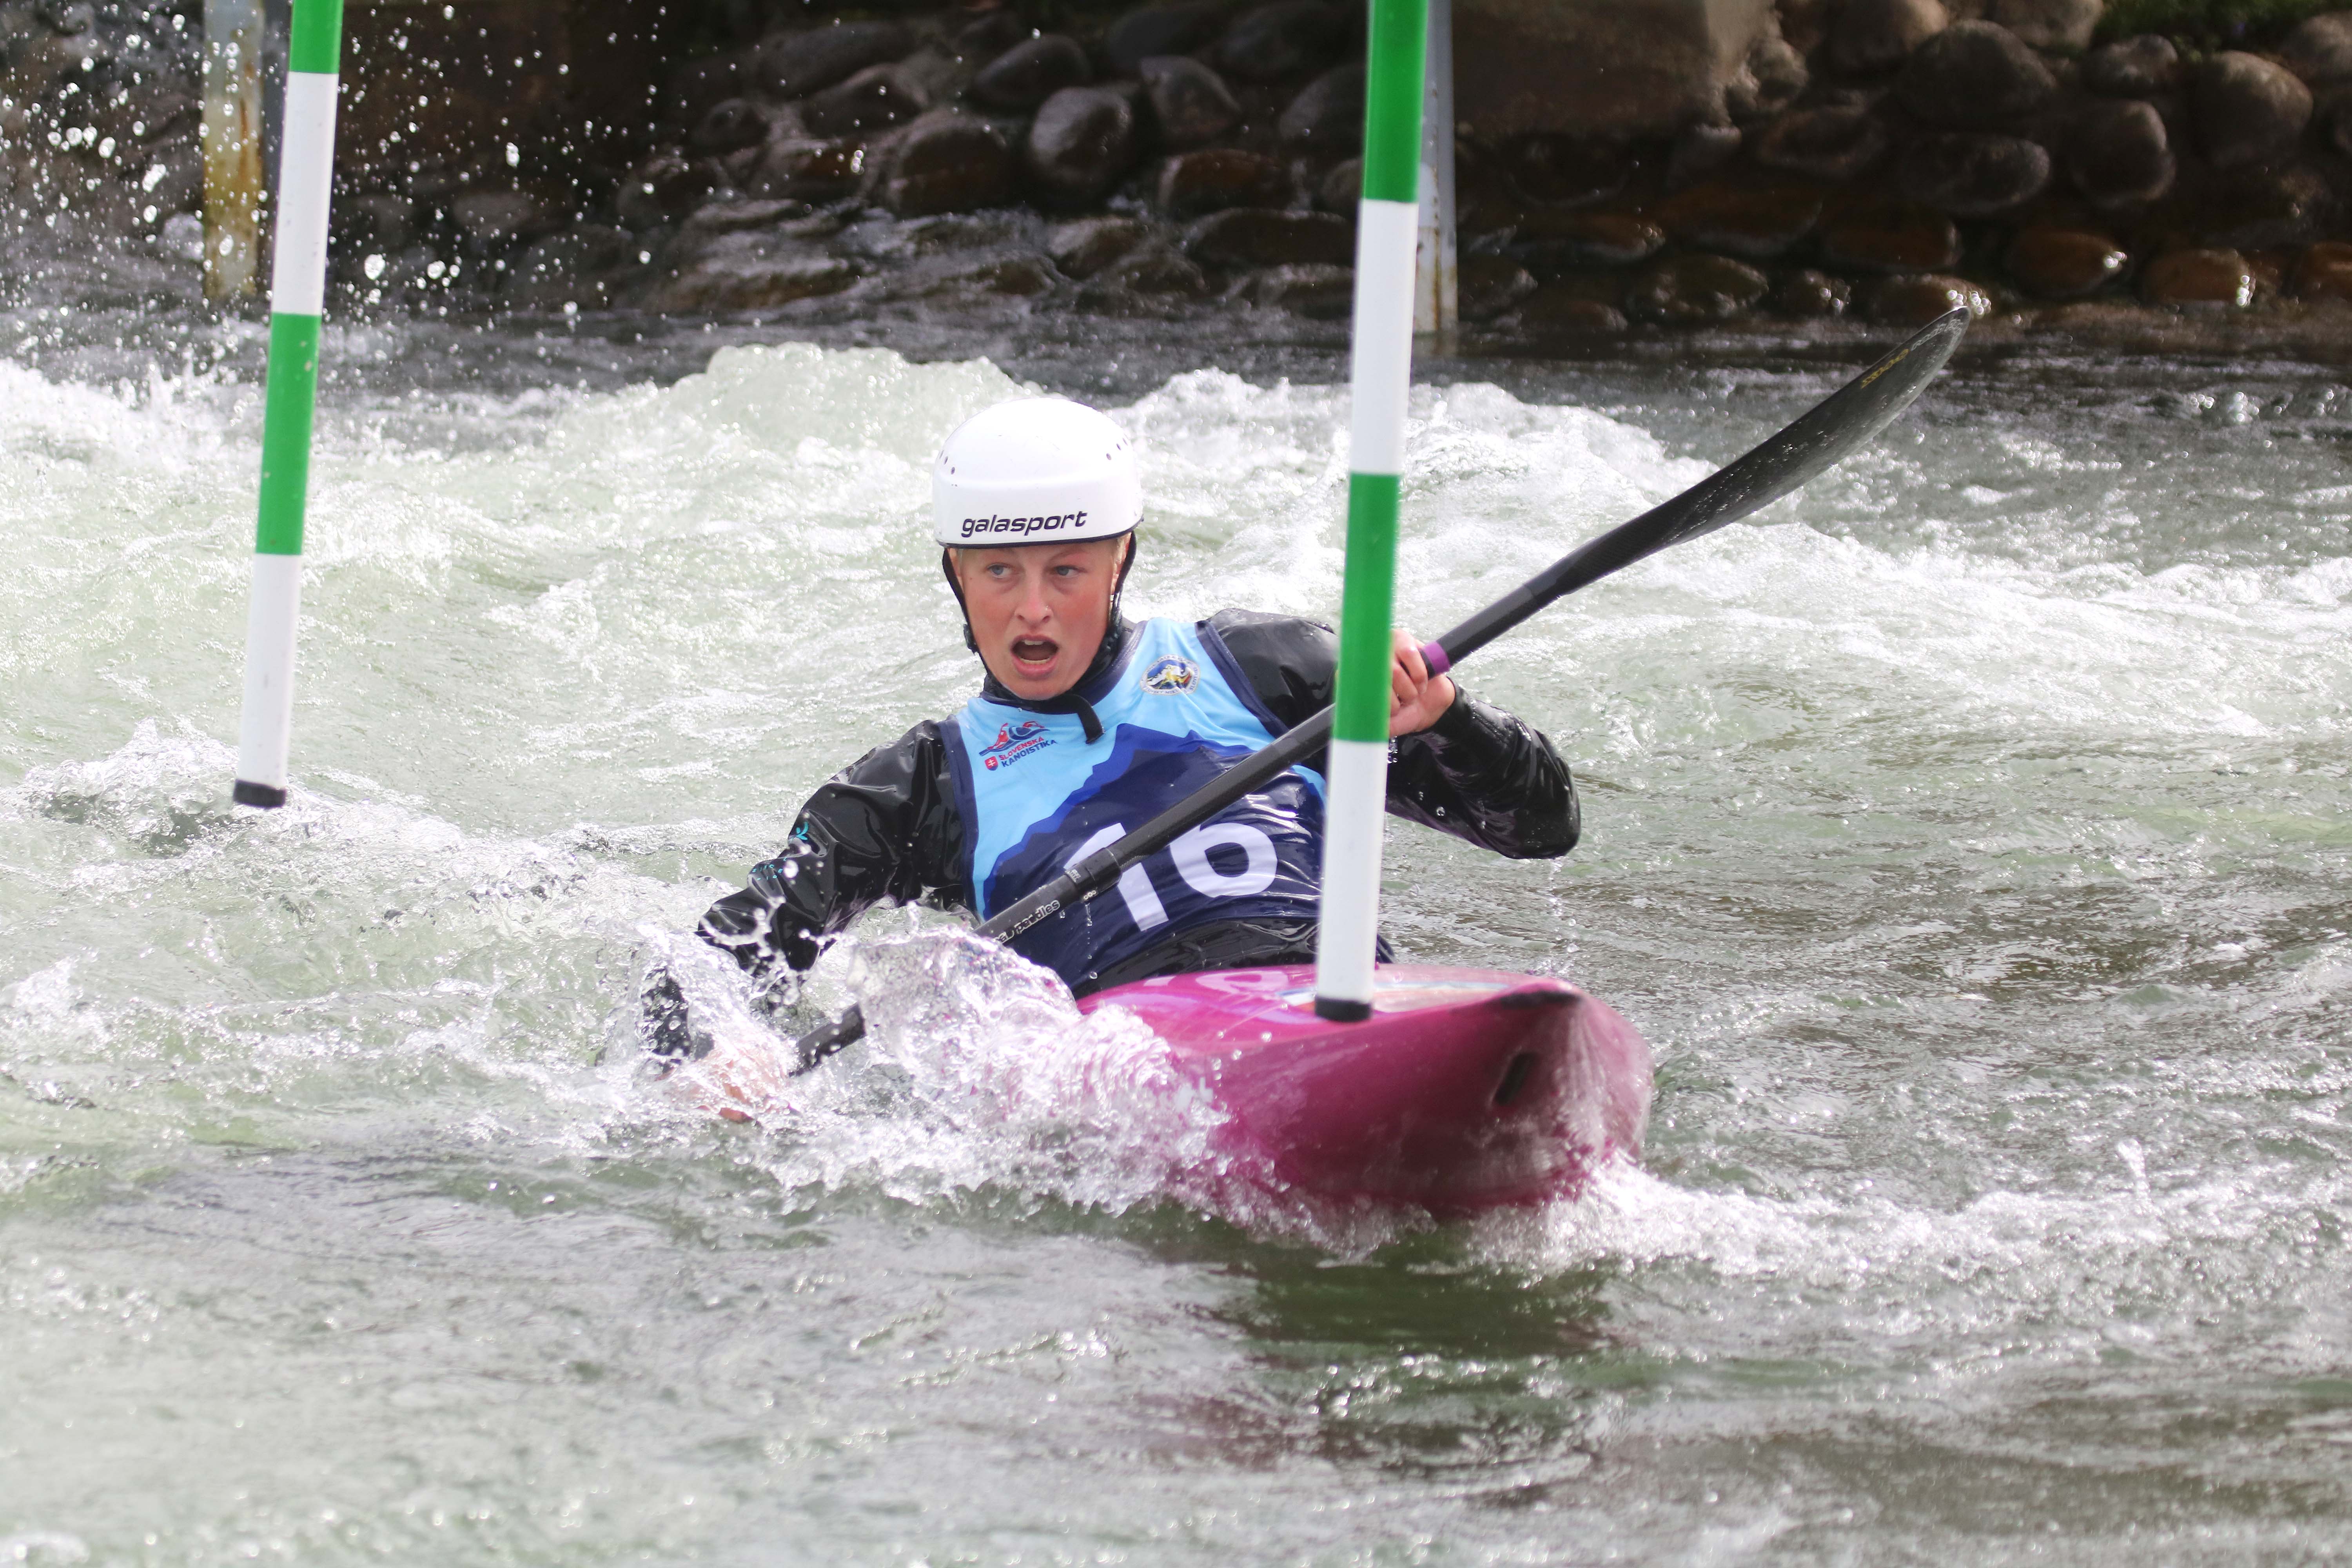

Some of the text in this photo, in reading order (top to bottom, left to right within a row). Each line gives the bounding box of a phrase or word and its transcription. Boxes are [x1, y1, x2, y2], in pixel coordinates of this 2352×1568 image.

[961, 511, 1088, 538] galasport
[998, 736, 1045, 760] SLOVENSKA
[1001, 739, 1058, 767] KANOISTIKA
[1064, 822, 1278, 932] 16
